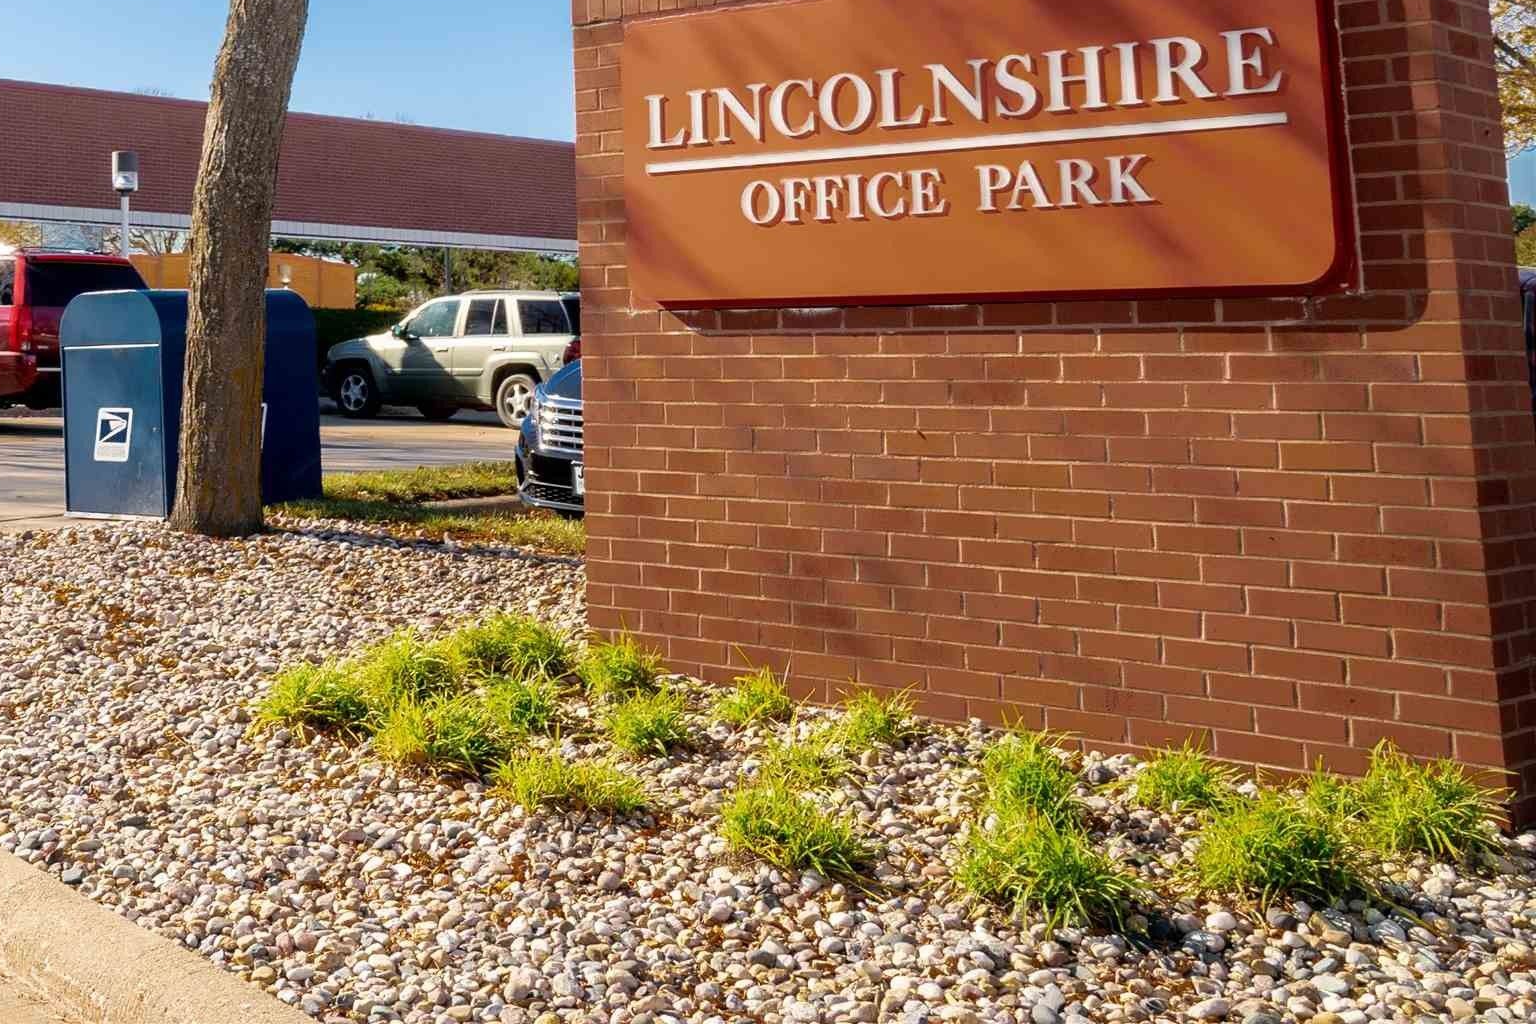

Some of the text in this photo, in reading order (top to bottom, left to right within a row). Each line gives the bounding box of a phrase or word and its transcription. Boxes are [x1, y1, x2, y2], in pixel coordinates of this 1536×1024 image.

[644, 27, 1282, 148] LINCOLNSHIRE
[740, 153, 1155, 224] OFFICE PARK
